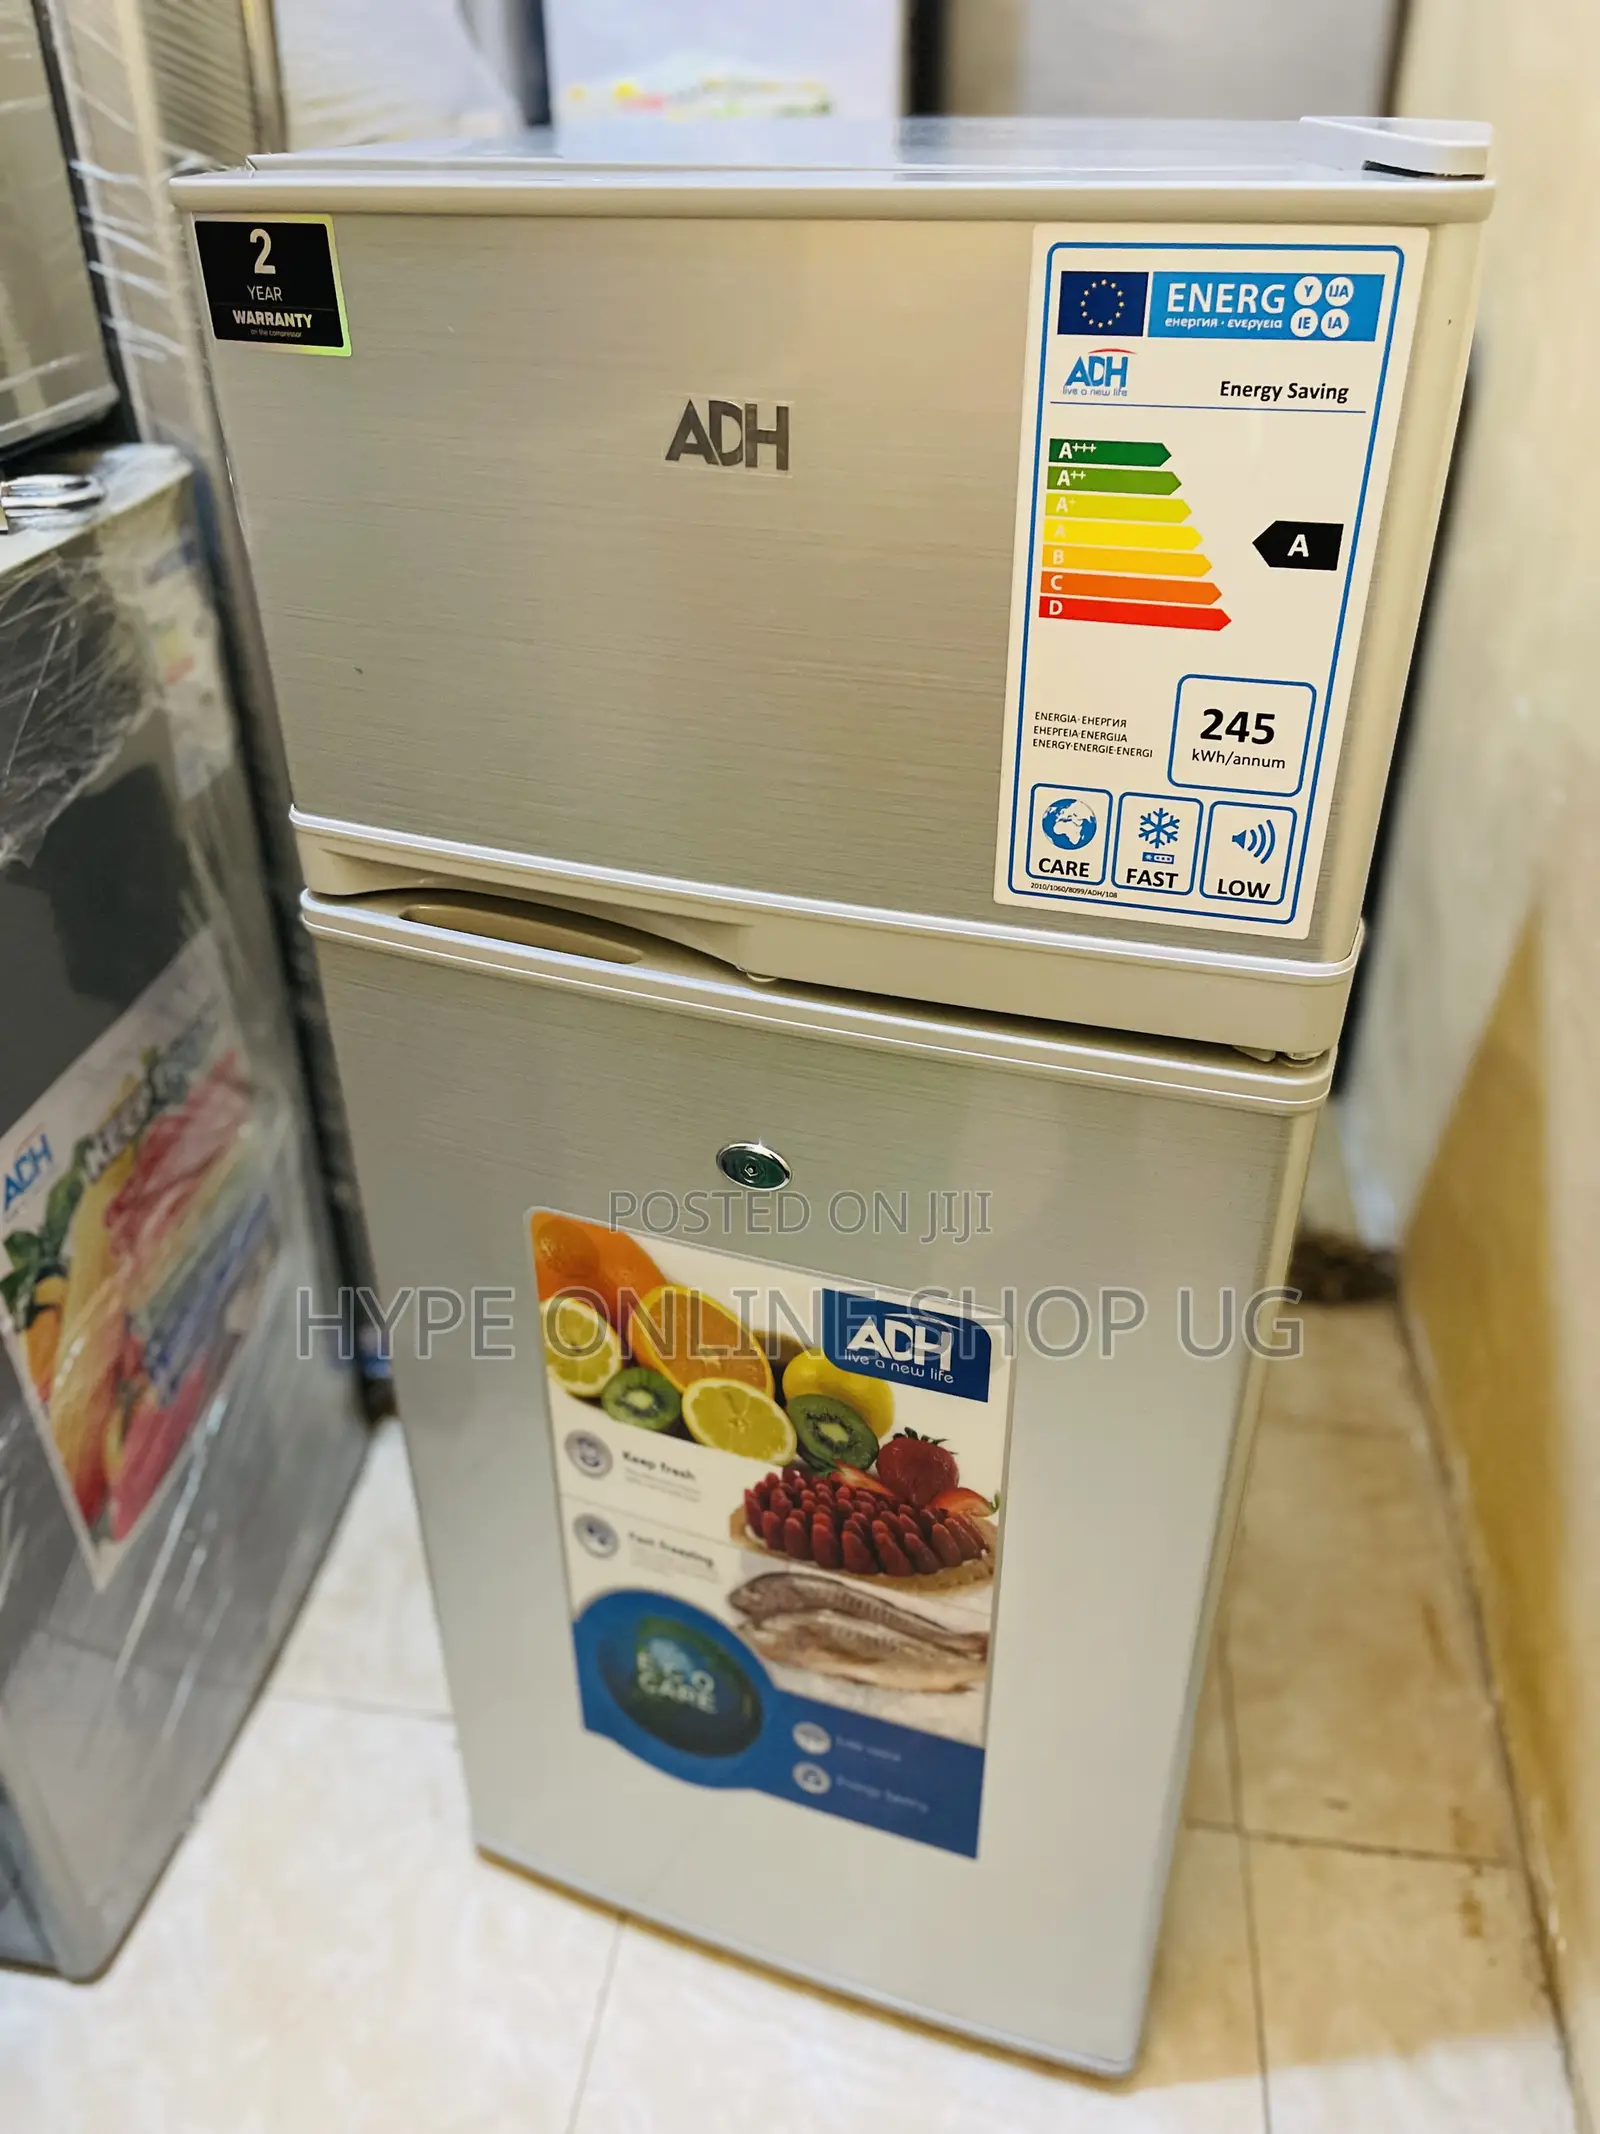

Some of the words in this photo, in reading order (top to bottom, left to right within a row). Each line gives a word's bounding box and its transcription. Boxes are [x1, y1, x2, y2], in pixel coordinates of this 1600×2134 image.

[250, 228, 276, 274] 2
[247, 285, 283, 302] YEAR
[1167, 283, 1285, 314] ENERG
[1303, 285, 1314, 297] Y
[232, 309, 313, 328] WARRANTY
[1298, 317, 1311, 330] IE
[1328, 317, 1343, 330] IA
[1064, 355, 1129, 387] ADH
[1063, 386, 1078, 395] live
[1114, 387, 1128, 397] life
[1219, 380, 1283, 401] Energy
[1287, 383, 1349, 404] Saving
[665, 399, 789, 471] ADH
[1059, 442, 1097, 459] A+++
[1057, 469, 1086, 487] A++
[1054, 524, 1067, 538] A
[1288, 535, 1309, 557] A
[1053, 549, 1065, 565] B
[1050, 575, 1064, 591] C
[1049, 600, 1064, 616] D
[1200, 709, 1276, 745] 245
[1192, 749, 1285, 769] kWh/annum
[1038, 858, 1090, 878] CARE
[1126, 868, 1178, 889] FAST
[1217, 878, 1271, 899] LOW
[847, 1316, 952, 1371] ADH
[844, 1349, 869, 1365] live
[875, 1359, 885, 1369] a
[891, 1362, 925, 1378] new
[930, 1367, 954, 1384] life
